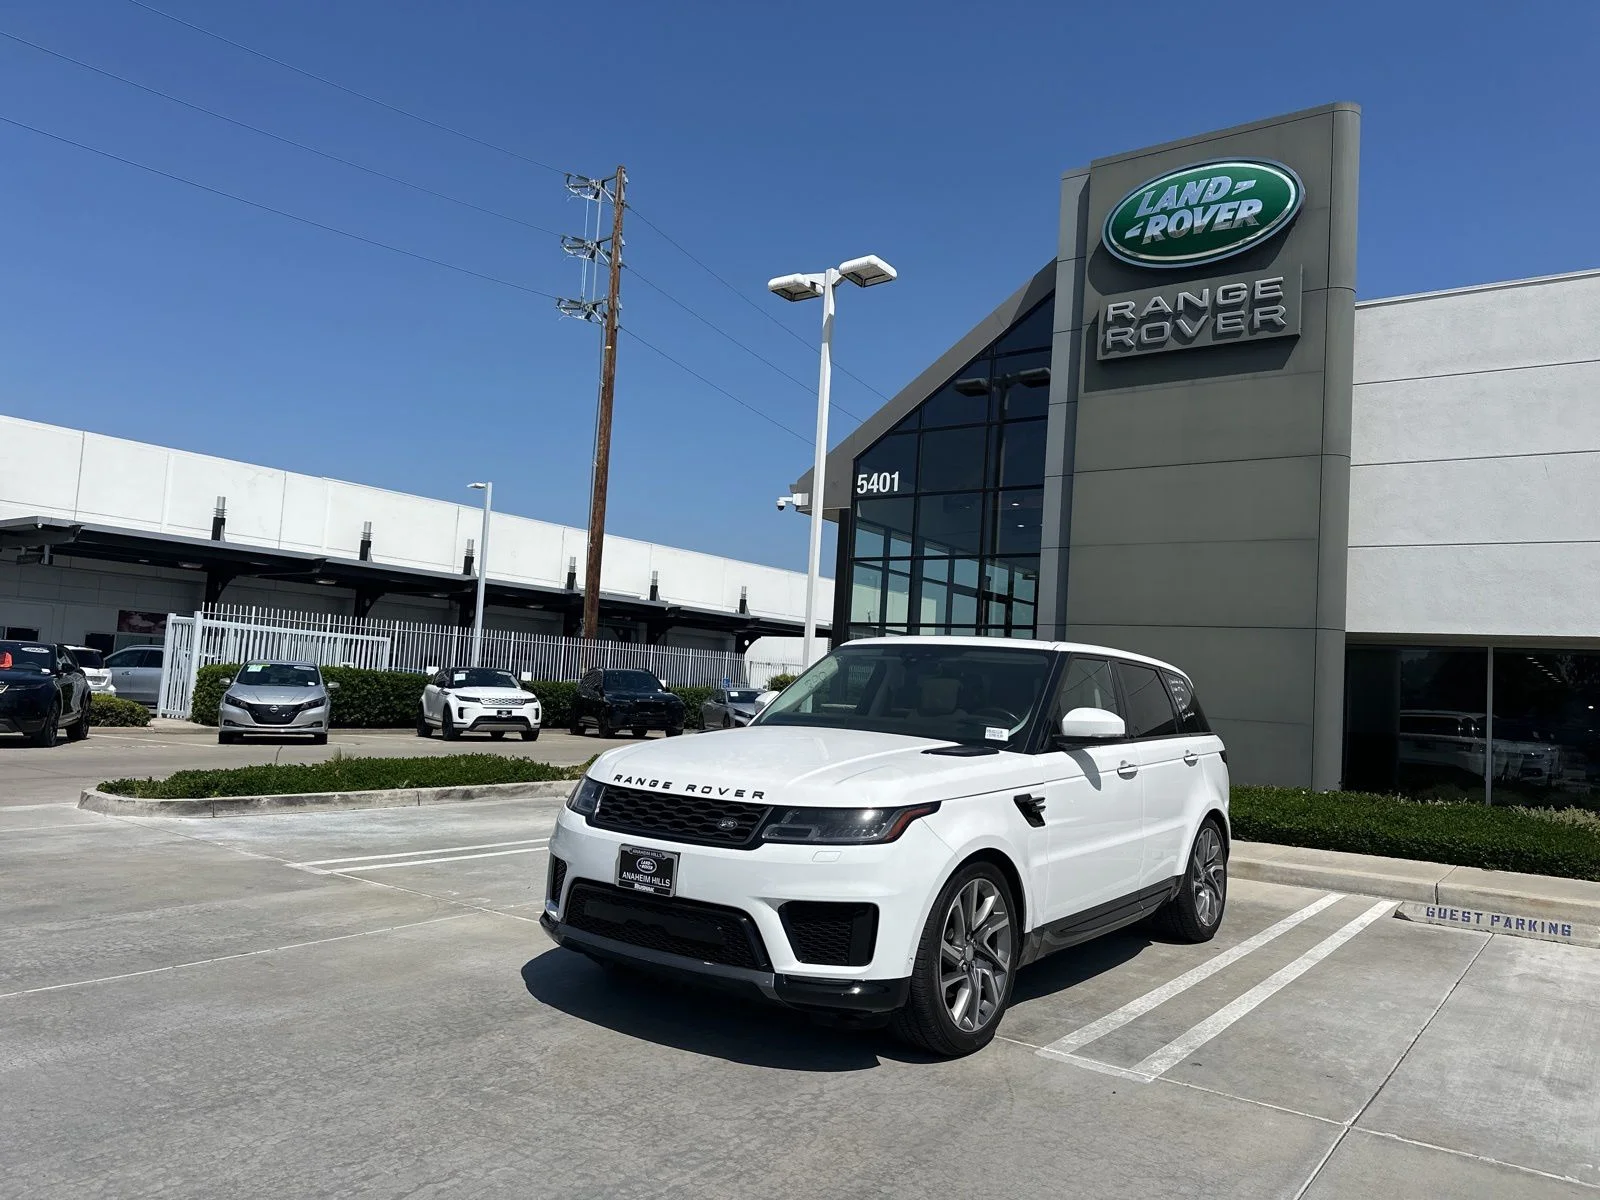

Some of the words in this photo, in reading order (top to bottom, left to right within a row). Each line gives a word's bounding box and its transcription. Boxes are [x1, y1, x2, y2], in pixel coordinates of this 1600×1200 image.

[1135, 175, 1232, 218] LAND
[1142, 199, 1263, 245] ROVER
[1106, 276, 1284, 323] RANGE
[1105, 304, 1287, 349] ROVER
[856, 470, 899, 494] 5401
[613, 774, 673, 790] RANGE
[685, 783, 765, 800] ROVER
[621, 871, 651, 883] ANAHEIM
[651, 876, 671, 887] HILLS
[1426, 906, 1483, 924] GUEST
[1490, 914, 1572, 937] PARKING
